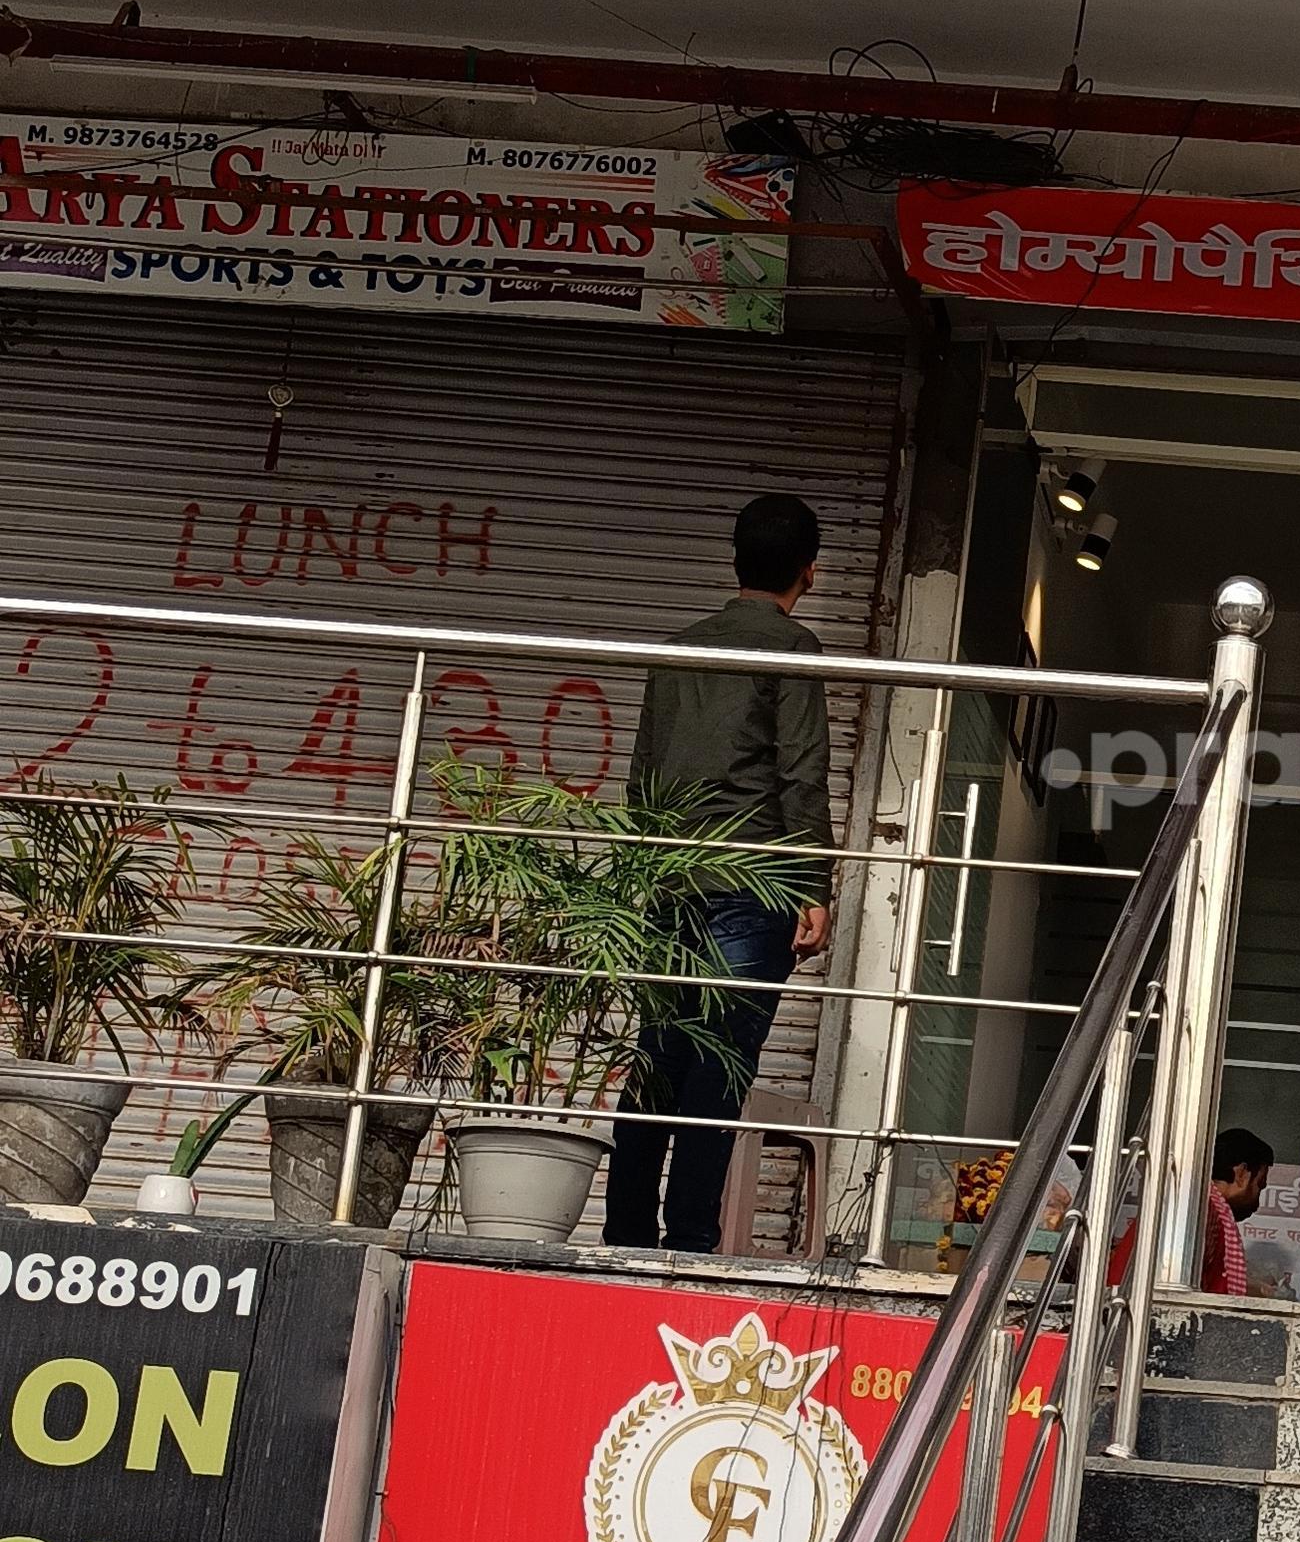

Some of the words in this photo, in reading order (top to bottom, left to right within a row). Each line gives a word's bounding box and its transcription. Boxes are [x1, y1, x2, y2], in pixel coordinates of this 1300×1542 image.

[63, 125, 219, 152] 9873764528
[502, 149, 658, 176] 8076776002
[111, 245, 294, 291] SPORTS
[171, 500, 500, 590] LUNCH
